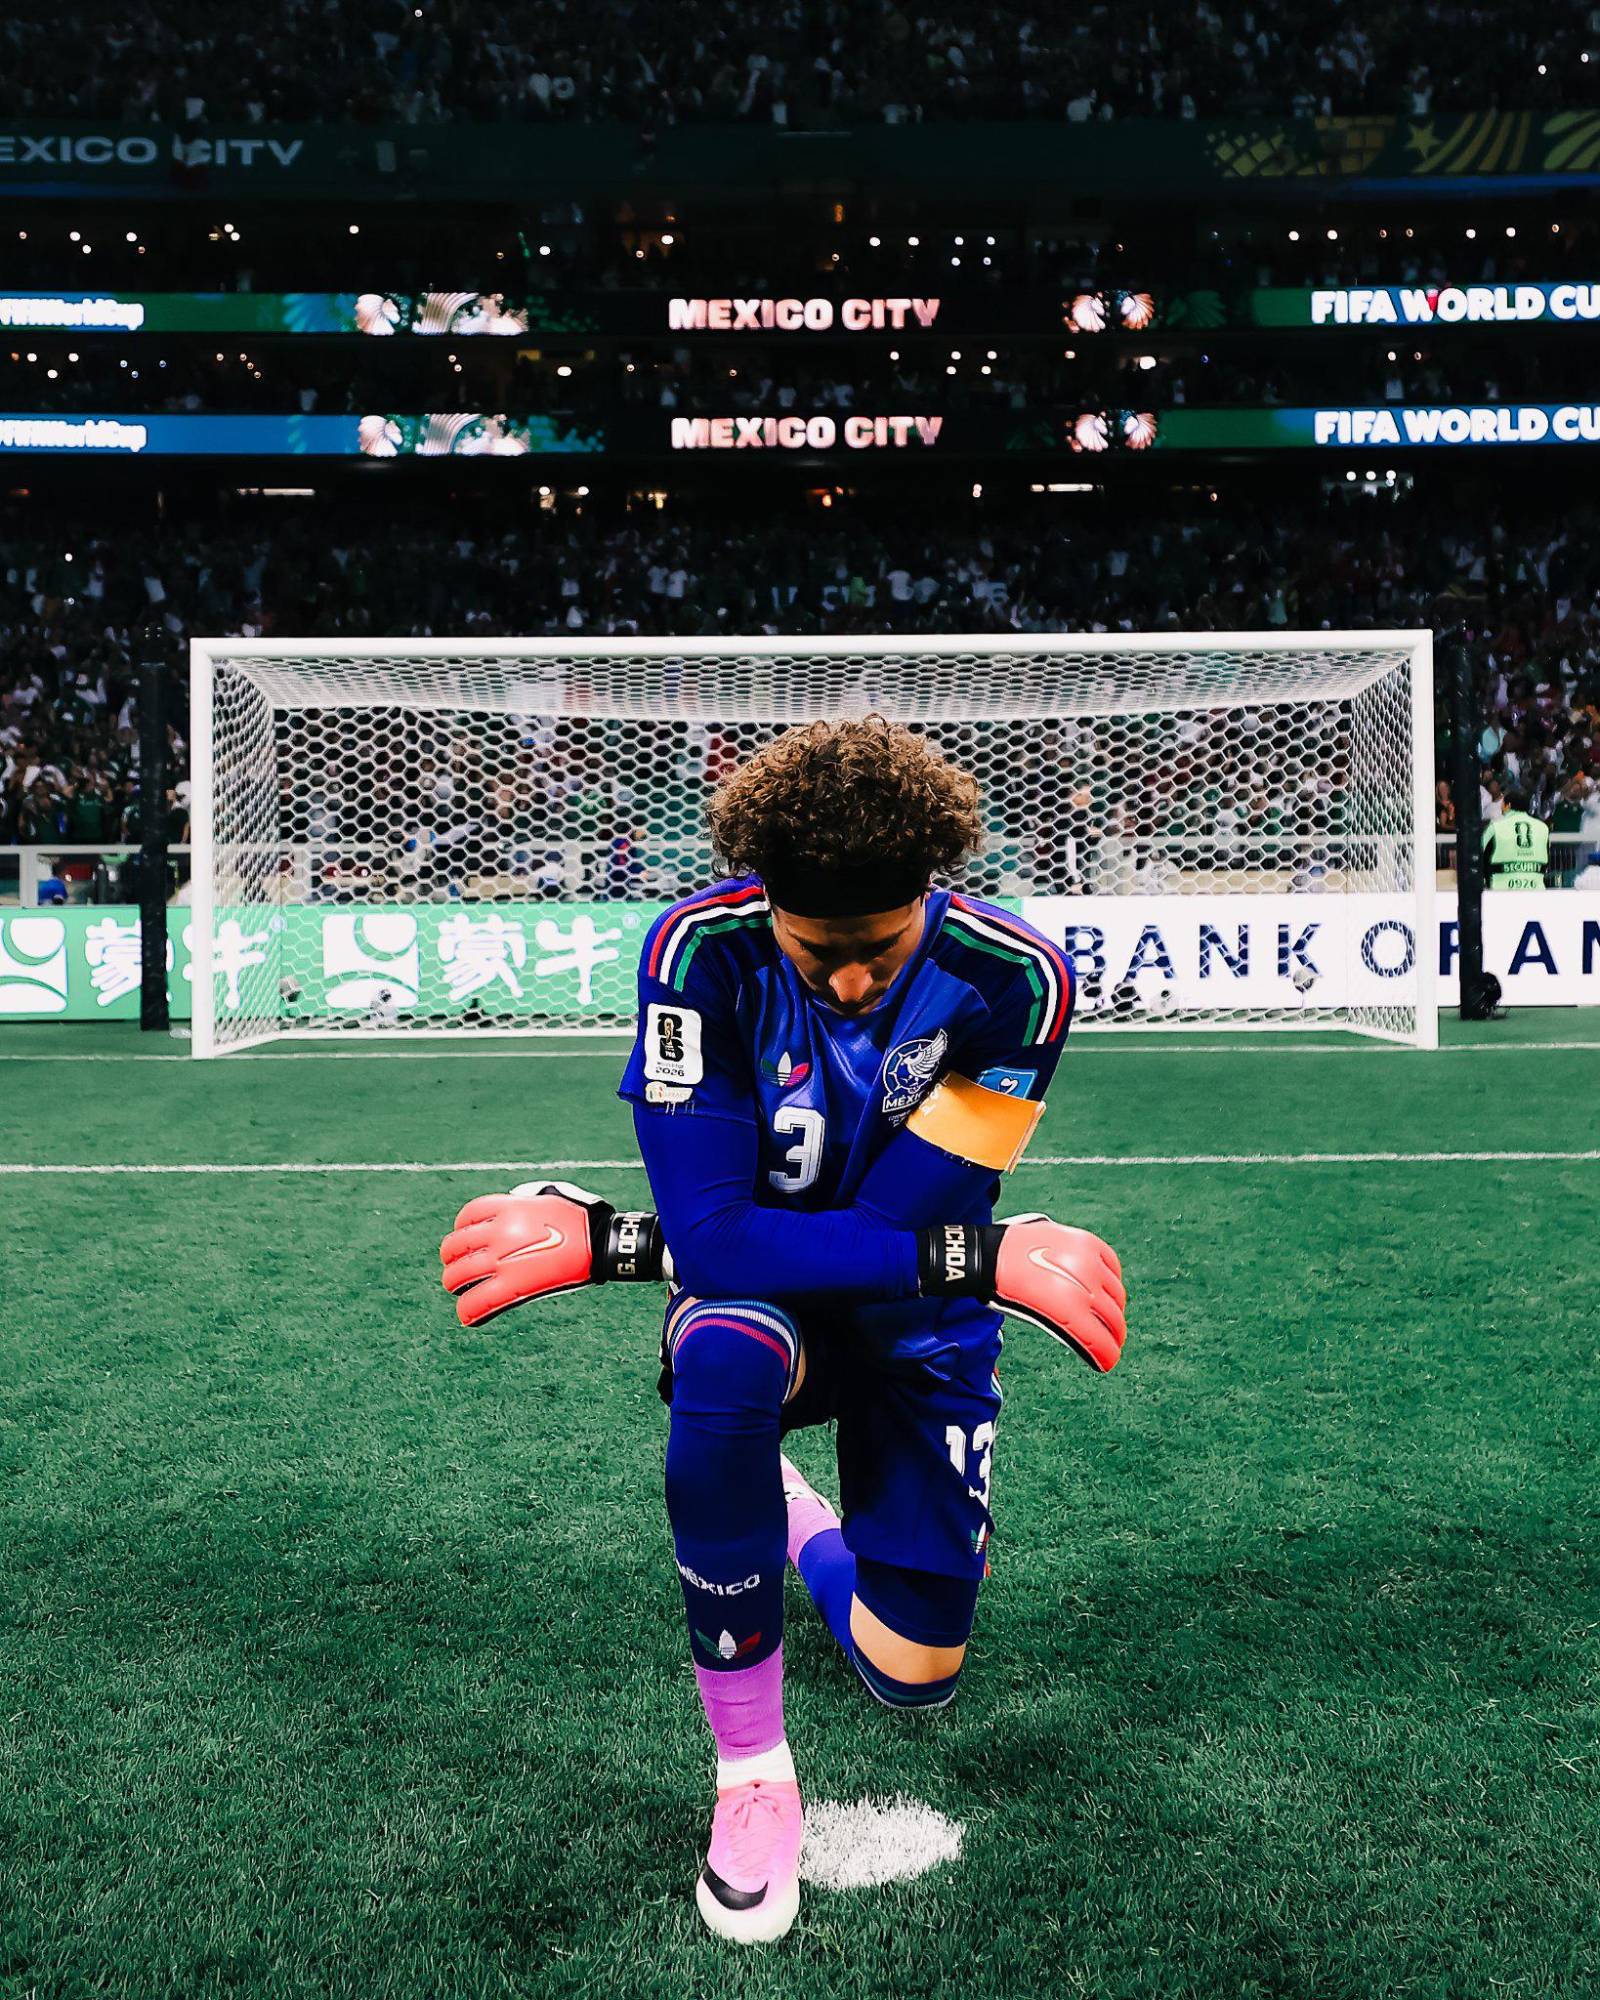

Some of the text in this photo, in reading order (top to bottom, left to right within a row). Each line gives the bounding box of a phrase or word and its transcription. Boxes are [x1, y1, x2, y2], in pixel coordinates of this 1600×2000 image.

[668, 298, 940, 331] MEXICO CITY
[1311, 289, 1398, 324] FIFA
[1399, 287, 1546, 322] WORLD
[670, 416, 943, 449] MEXICO CITY
[1314, 410, 1401, 445] FIFA
[1402, 408, 1550, 443] WORLD
[437, 912, 623, 1005] 蒙牛
[1065, 923, 1322, 978] BANK
[768, 1105, 826, 1194] 3
[617, 1258, 636, 1275] G.
